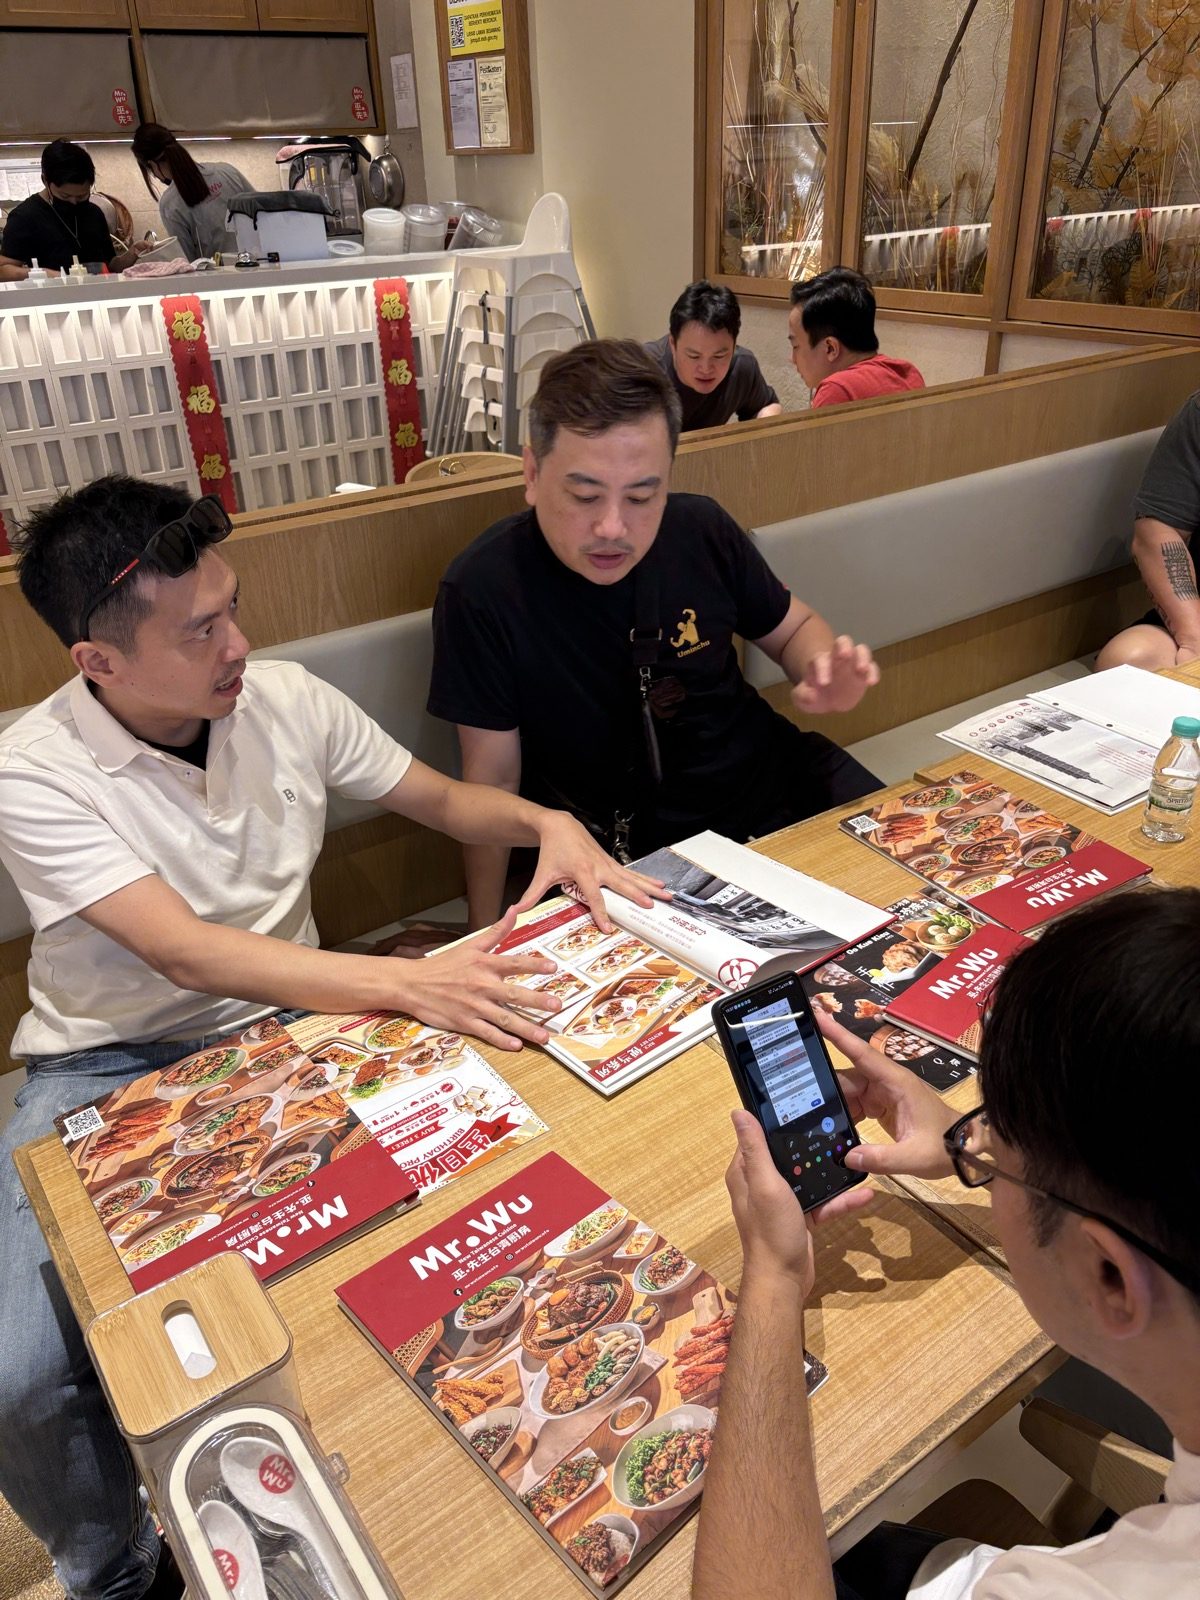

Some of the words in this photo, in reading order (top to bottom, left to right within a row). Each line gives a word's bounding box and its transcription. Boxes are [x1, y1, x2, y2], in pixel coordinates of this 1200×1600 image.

[381, 292, 405, 321] 福
[172, 311, 201, 341] 福
[388, 359, 412, 386] 福
[187, 385, 215, 414] 福
[395, 422, 418, 448] 福
[201, 454, 226, 480] 福
[419, 1125, 436, 1136] BUY
[423, 1128, 465, 1160] BIRTHDAY
[258, 1217, 289, 1237] Taiwanese
[289, 1209, 303, 1220] New
[235, 1235, 258, 1249] Cuisine
[457, 1253, 471, 1264] New
[469, 1235, 498, 1256] Taiwanese
[497, 1222, 517, 1237] Cuisine
[262, 1470, 287, 1489] Wu
[270, 1457, 294, 1481] Mr.
[218, 1554, 235, 1585] Mr.
